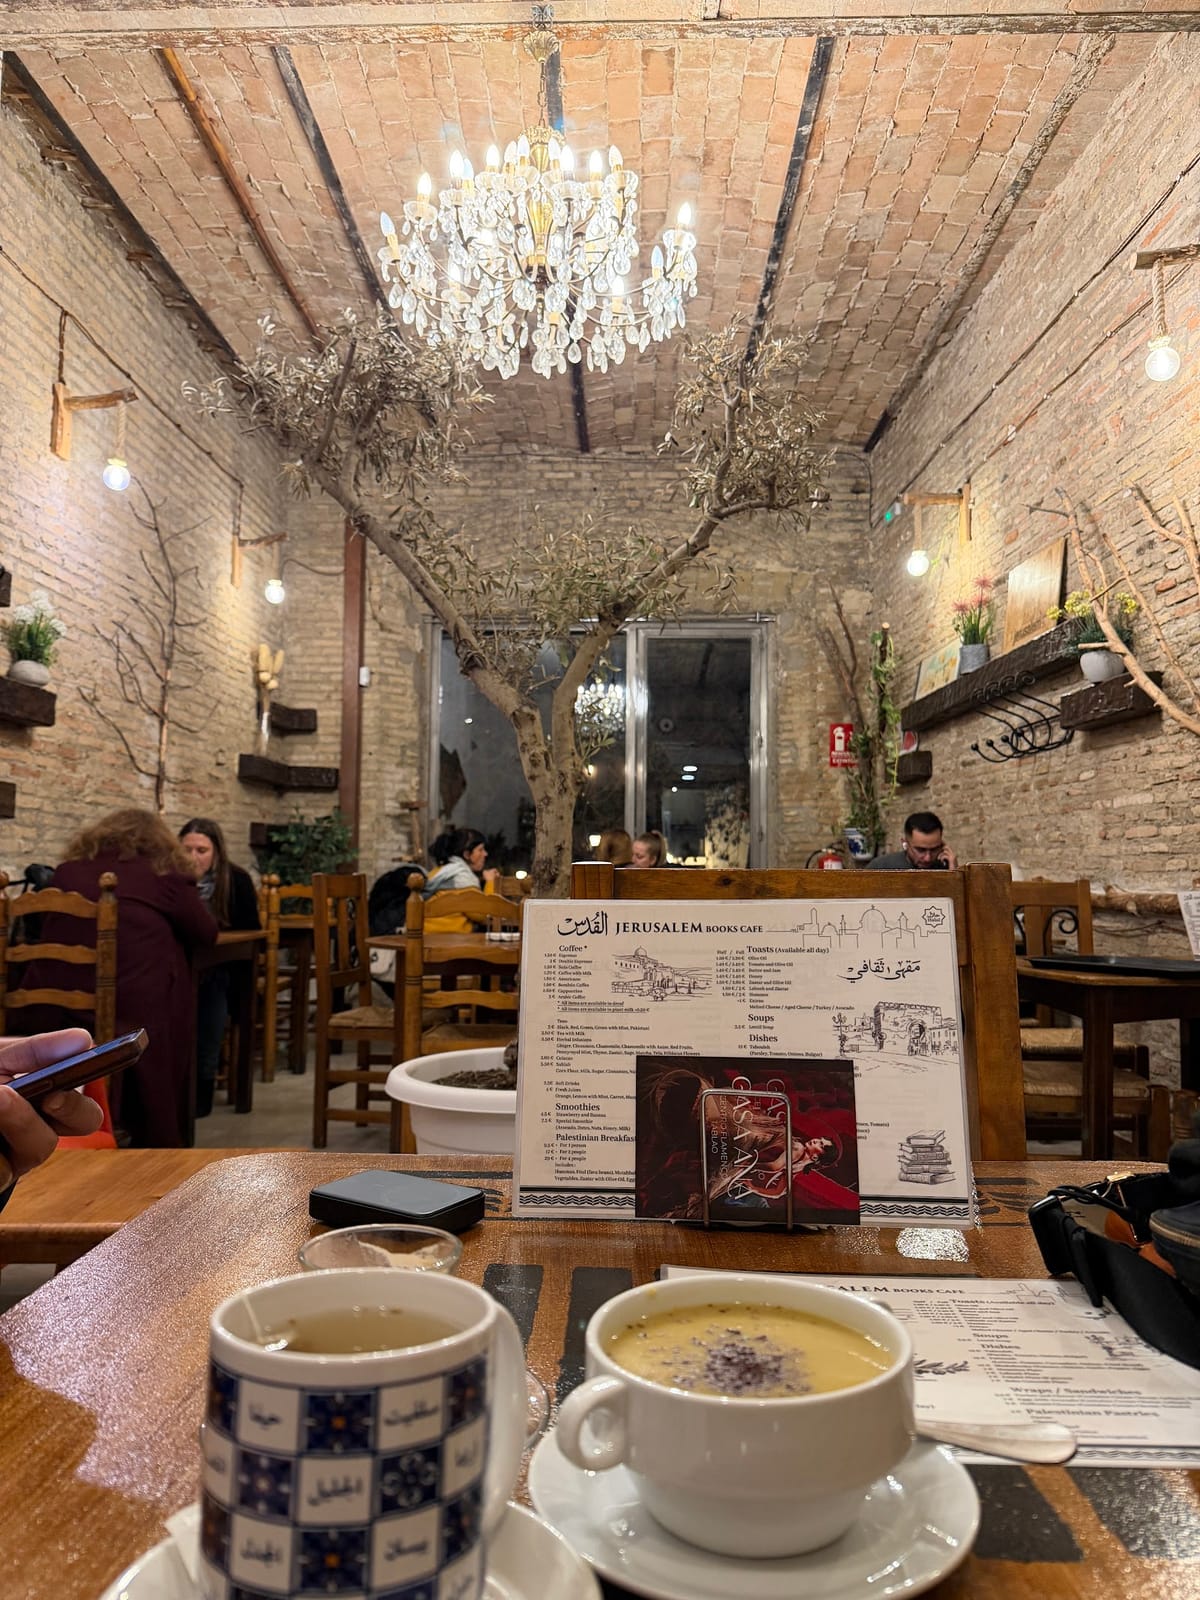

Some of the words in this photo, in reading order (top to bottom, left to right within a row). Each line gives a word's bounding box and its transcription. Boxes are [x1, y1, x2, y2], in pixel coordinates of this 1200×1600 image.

[615, 922, 702, 935] JERUSALEM
[559, 944, 583, 952] Coffee
[748, 1014, 775, 1023] Soups
[749, 1034, 778, 1042] Dishes
[556, 1103, 600, 1111] Smoothies
[732, 1076, 753, 1141] CASA
[556, 1134, 599, 1142] Palestinian
[600, 1134, 636, 1142] Breakfas
[720, 1132, 728, 1180] FLAMENCO
